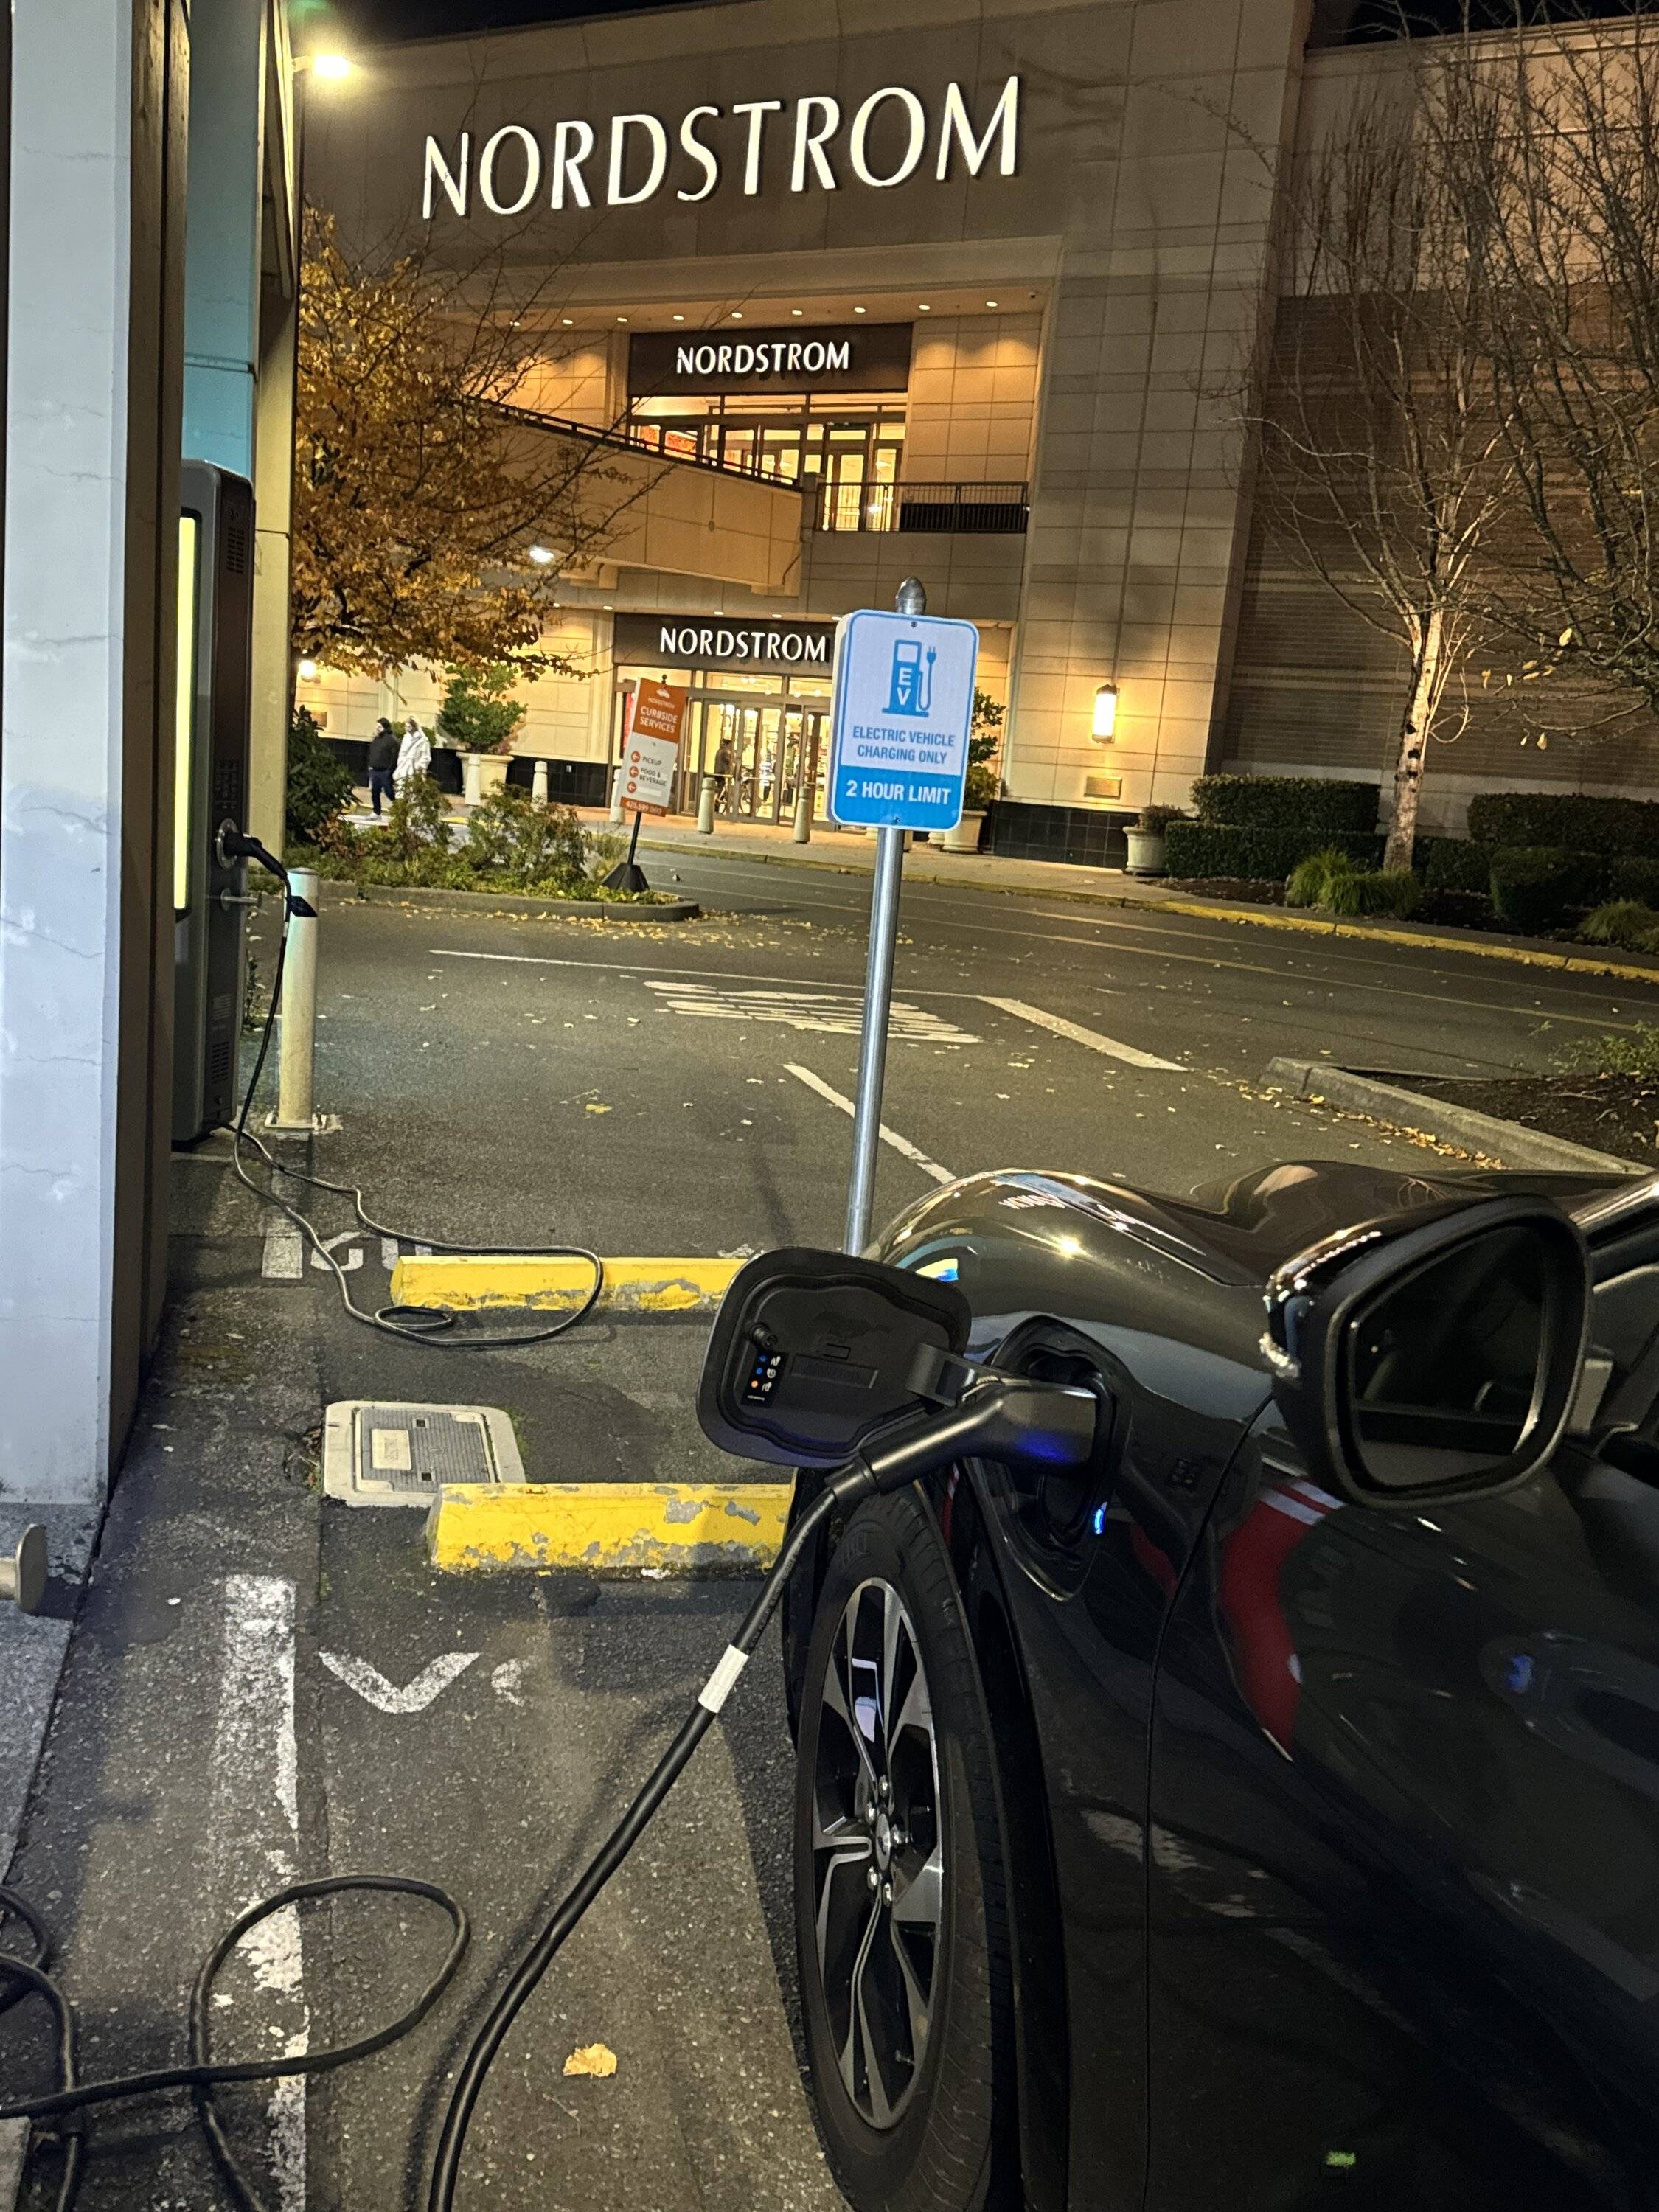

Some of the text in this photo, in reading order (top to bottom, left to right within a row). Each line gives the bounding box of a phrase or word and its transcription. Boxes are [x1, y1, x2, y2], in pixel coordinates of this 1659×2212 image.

[422, 76, 1018, 219] NORDSTROM
[676, 341, 850, 375] NORDSTROM
[660, 627, 827, 662] NORDSTROM
[897, 667, 912, 706] EV
[639, 717, 675, 733] SERVICES
[640, 706, 678, 723] CURBSIDE
[852, 726, 955, 747] ELECTRIC VEHICLE
[857, 744, 947, 765] CHARGING ONLY
[639, 774, 667, 787] BEVERAGE
[641, 767, 656, 777] FOOD
[846, 779, 952, 805] 2 HOUR LIMIT
[644, 981, 984, 1043] STOP
